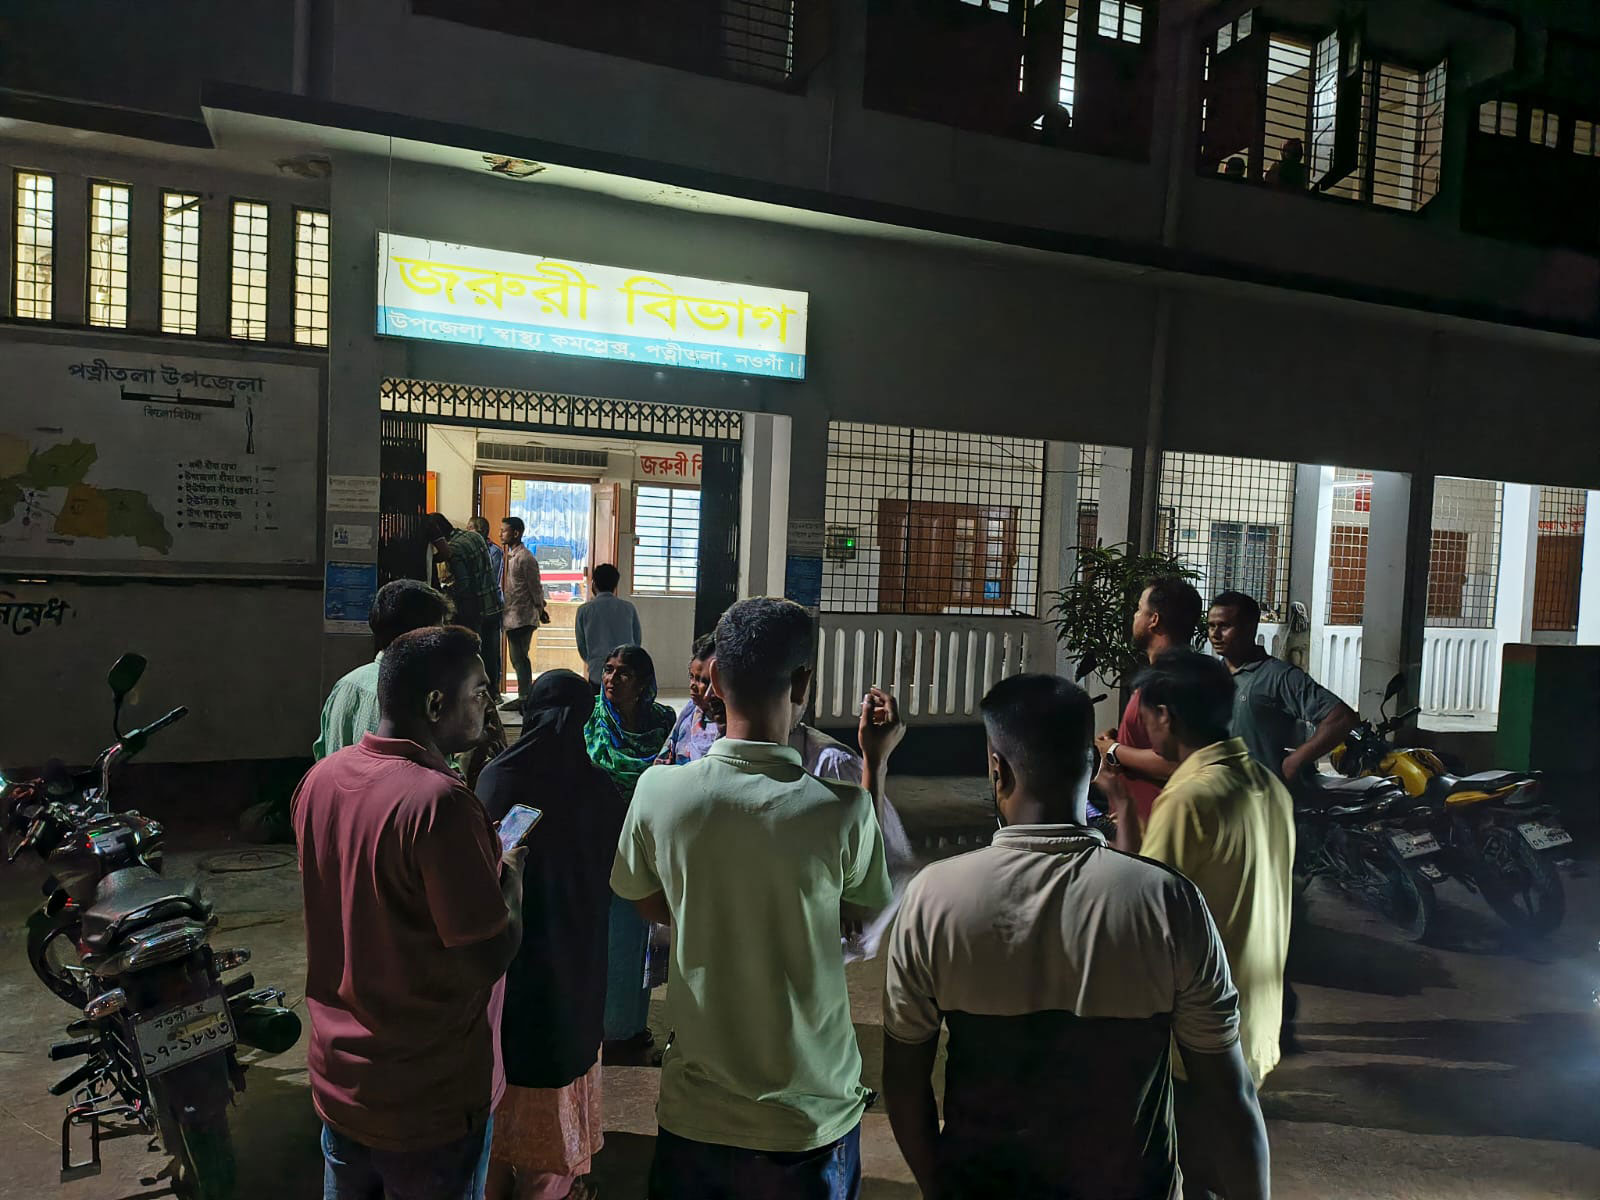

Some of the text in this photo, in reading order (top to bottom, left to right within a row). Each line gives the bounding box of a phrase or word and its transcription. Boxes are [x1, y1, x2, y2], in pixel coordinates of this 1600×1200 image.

[390, 256, 798, 344] জরুরী বিভাগ
[388, 311, 485, 340] উপজেলা
[160, 363, 267, 392] উপজেলা
[640, 451, 689, 477] জরুরী
